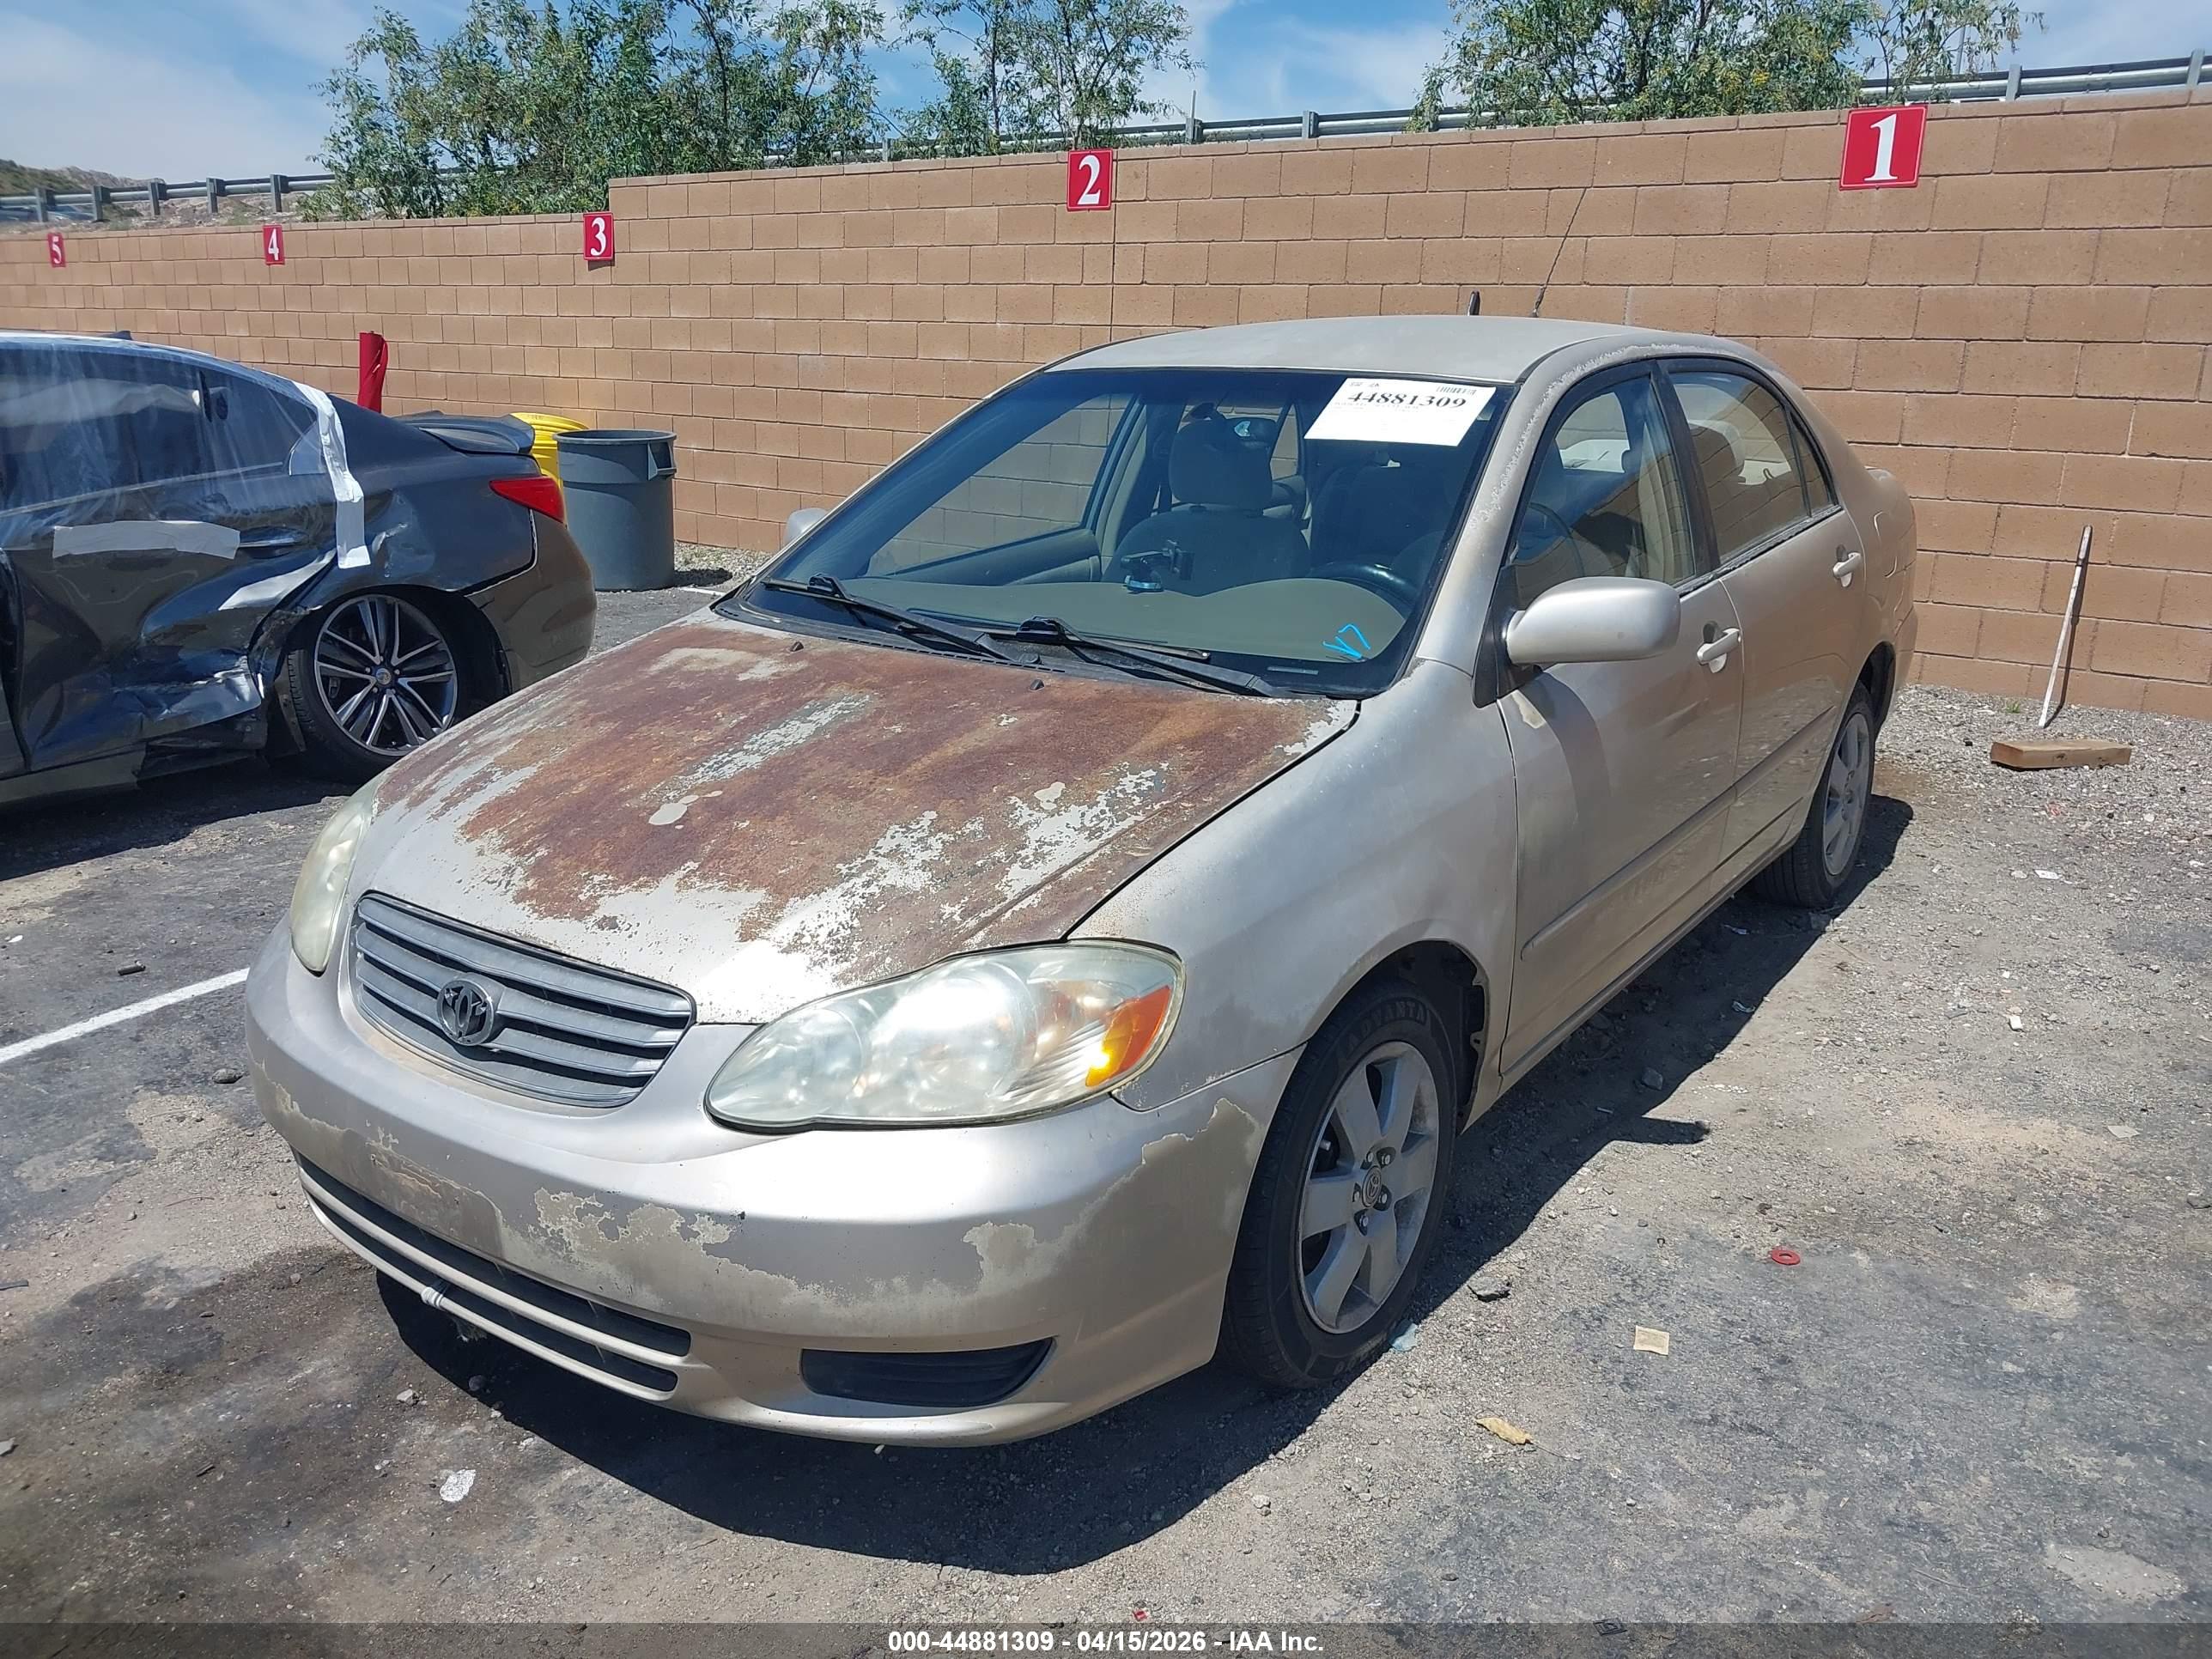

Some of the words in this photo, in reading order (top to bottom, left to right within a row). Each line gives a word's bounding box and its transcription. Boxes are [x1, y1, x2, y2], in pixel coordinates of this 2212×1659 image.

[1864, 112, 1898, 181] 1
[1077, 155, 1101, 205] 2
[52, 235, 62, 264] 5
[268, 228, 279, 261] 4
[590, 216, 606, 256] 3
[1348, 391, 1467, 409] 44881309
